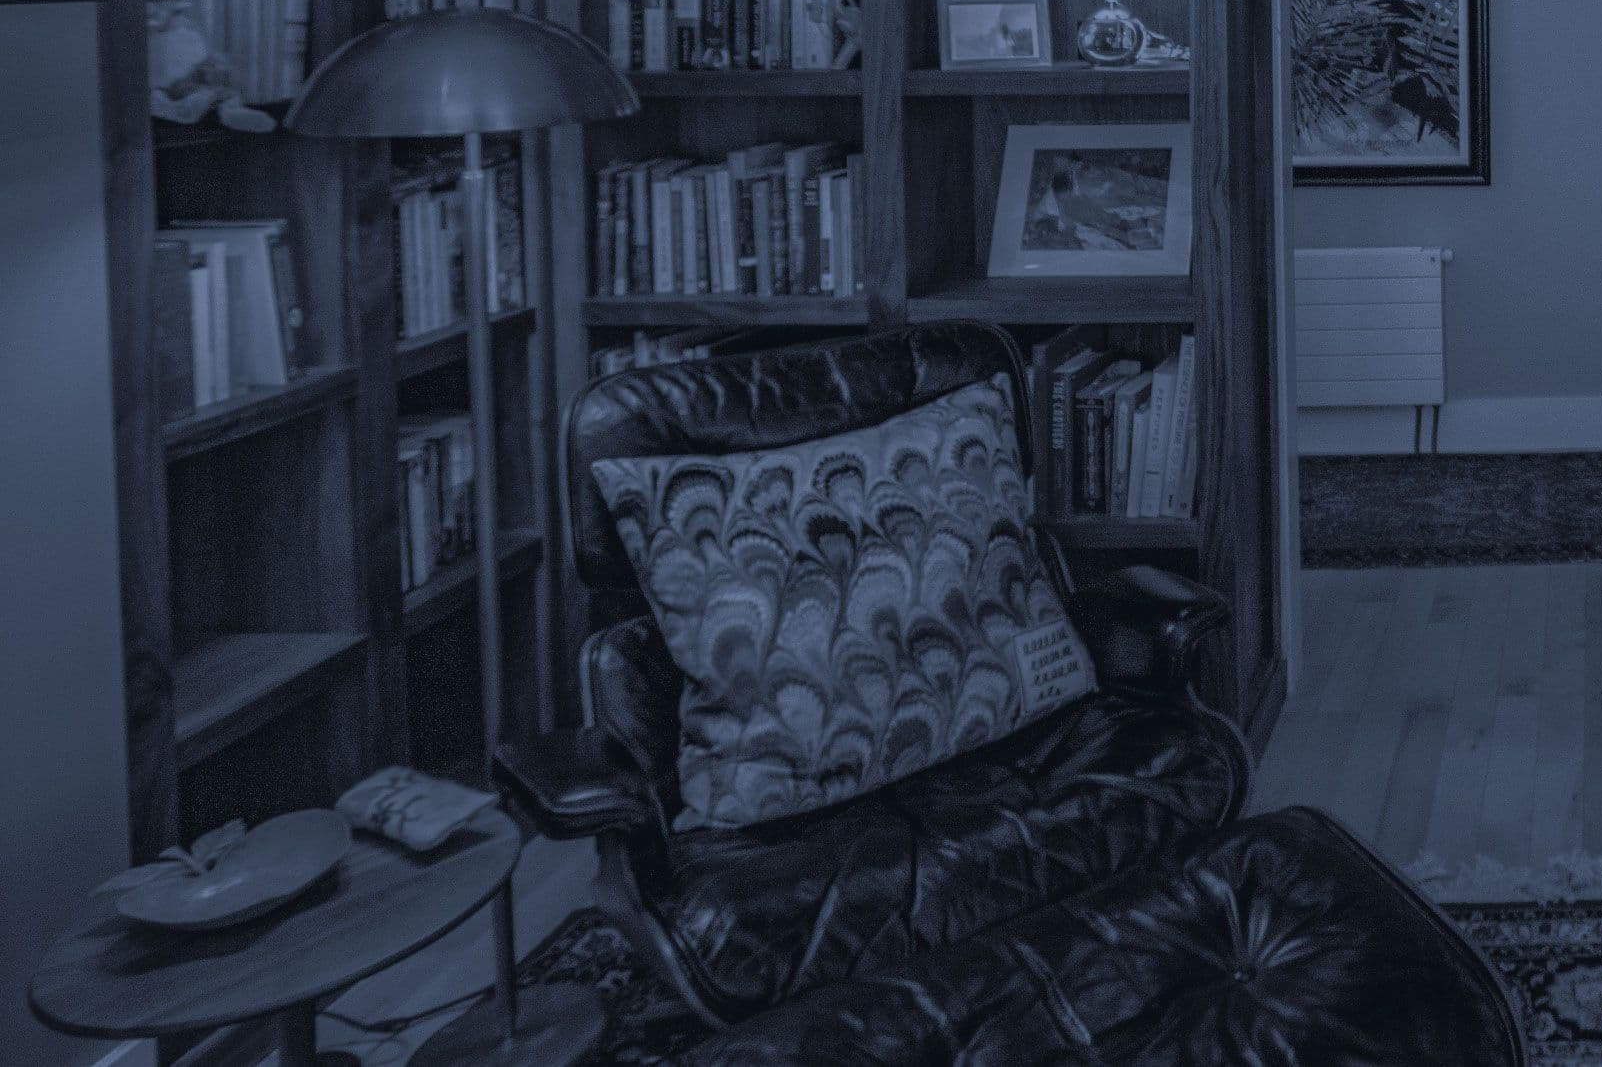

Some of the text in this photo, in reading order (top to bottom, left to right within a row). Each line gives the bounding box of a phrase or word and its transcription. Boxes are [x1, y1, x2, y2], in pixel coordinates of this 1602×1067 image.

[1052, 381, 1065, 450] THE CARTIERS
[1151, 387, 1165, 452] PERFUMES
[1173, 343, 1194, 445] THE ESSENCE OF PERFUME
